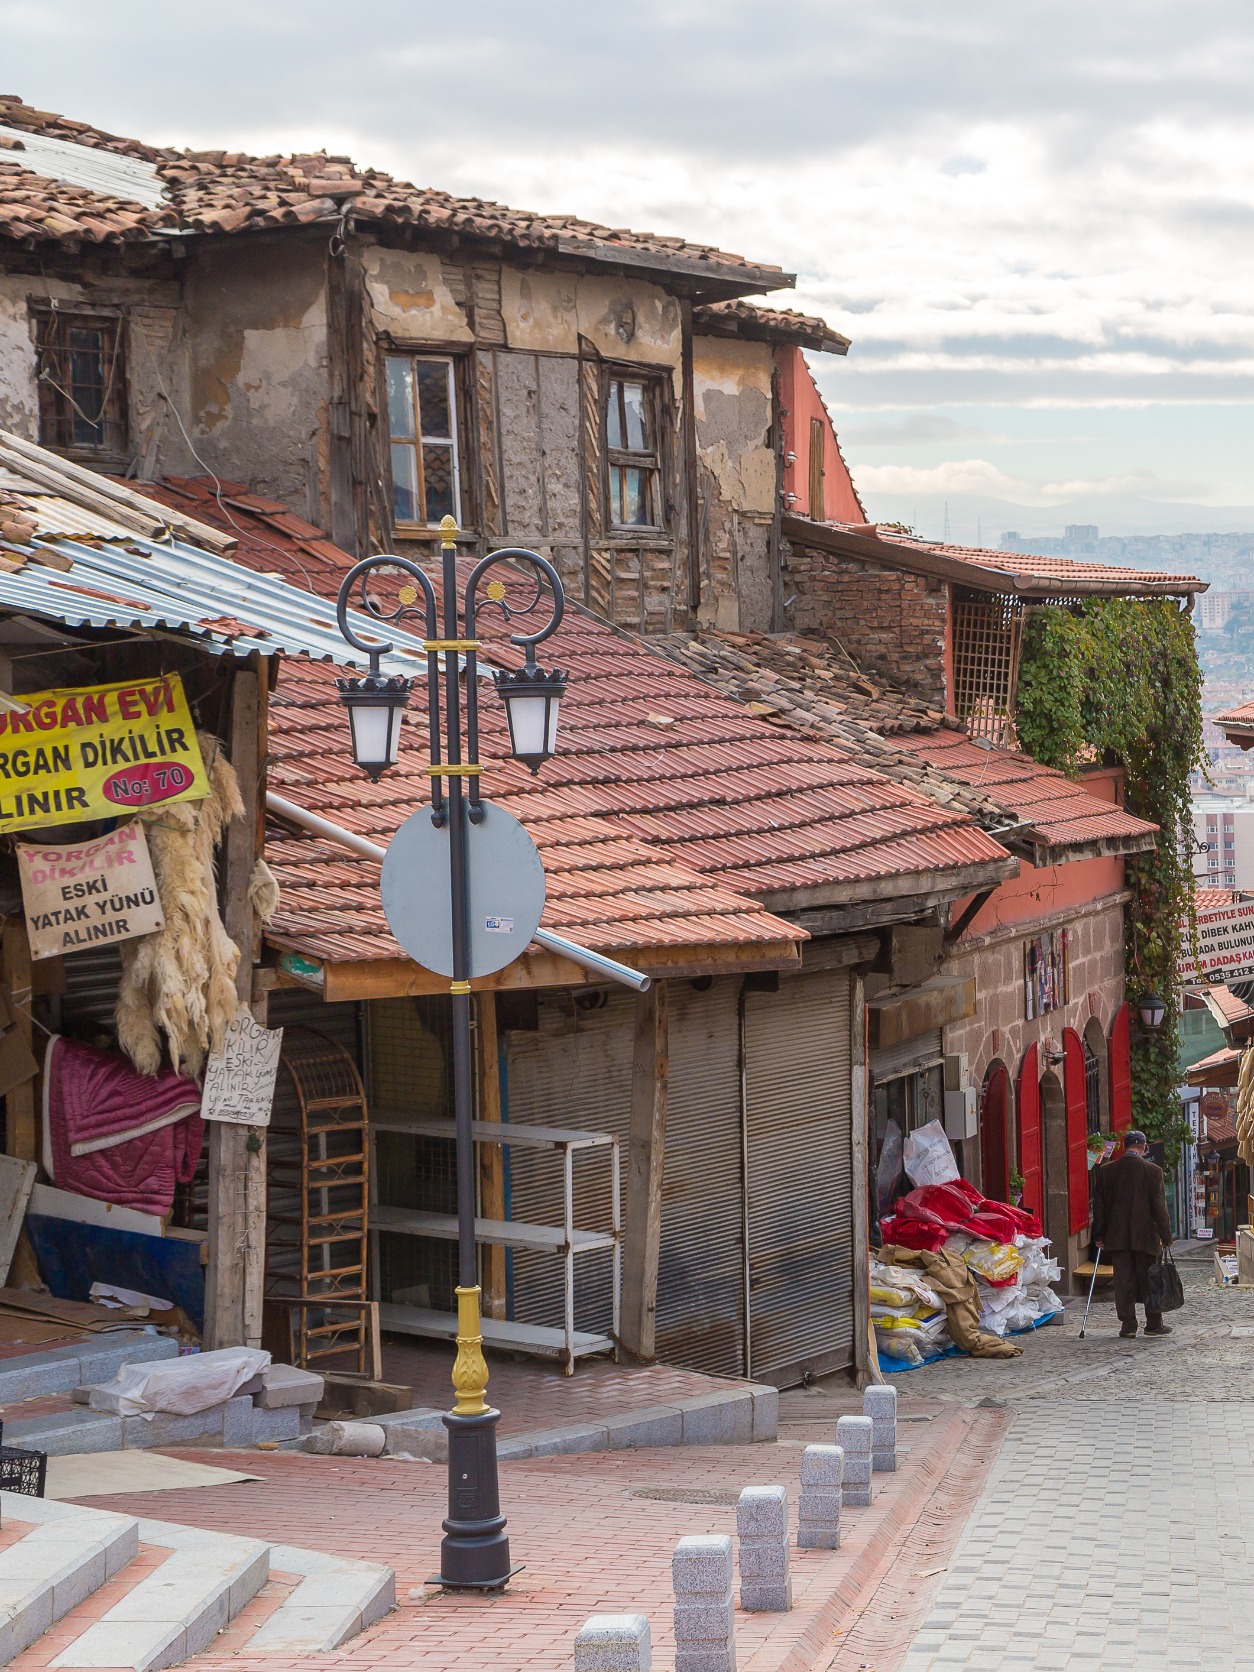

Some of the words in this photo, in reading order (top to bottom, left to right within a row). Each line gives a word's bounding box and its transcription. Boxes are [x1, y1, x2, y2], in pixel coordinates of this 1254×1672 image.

[0, 693, 109, 736] RGAN
[80, 724, 190, 769] DİKİLİR
[111, 778, 150, 798] No:
[153, 767, 185, 789] 70
[22, 826, 138, 863] YORGAN
[61, 874, 108, 901] ESKİ
[30, 904, 91, 931] YATAK
[95, 887, 155, 916] YÜNÜ
[62, 918, 130, 947] ALINIR
[1201, 926, 1230, 940] DİBEK
[1181, 943, 1217, 959] BUADA
[1209, 952, 1242, 968] DADAŞ
[1209, 970, 1231, 982] 0535
[1233, 967, 1250, 977] 412
